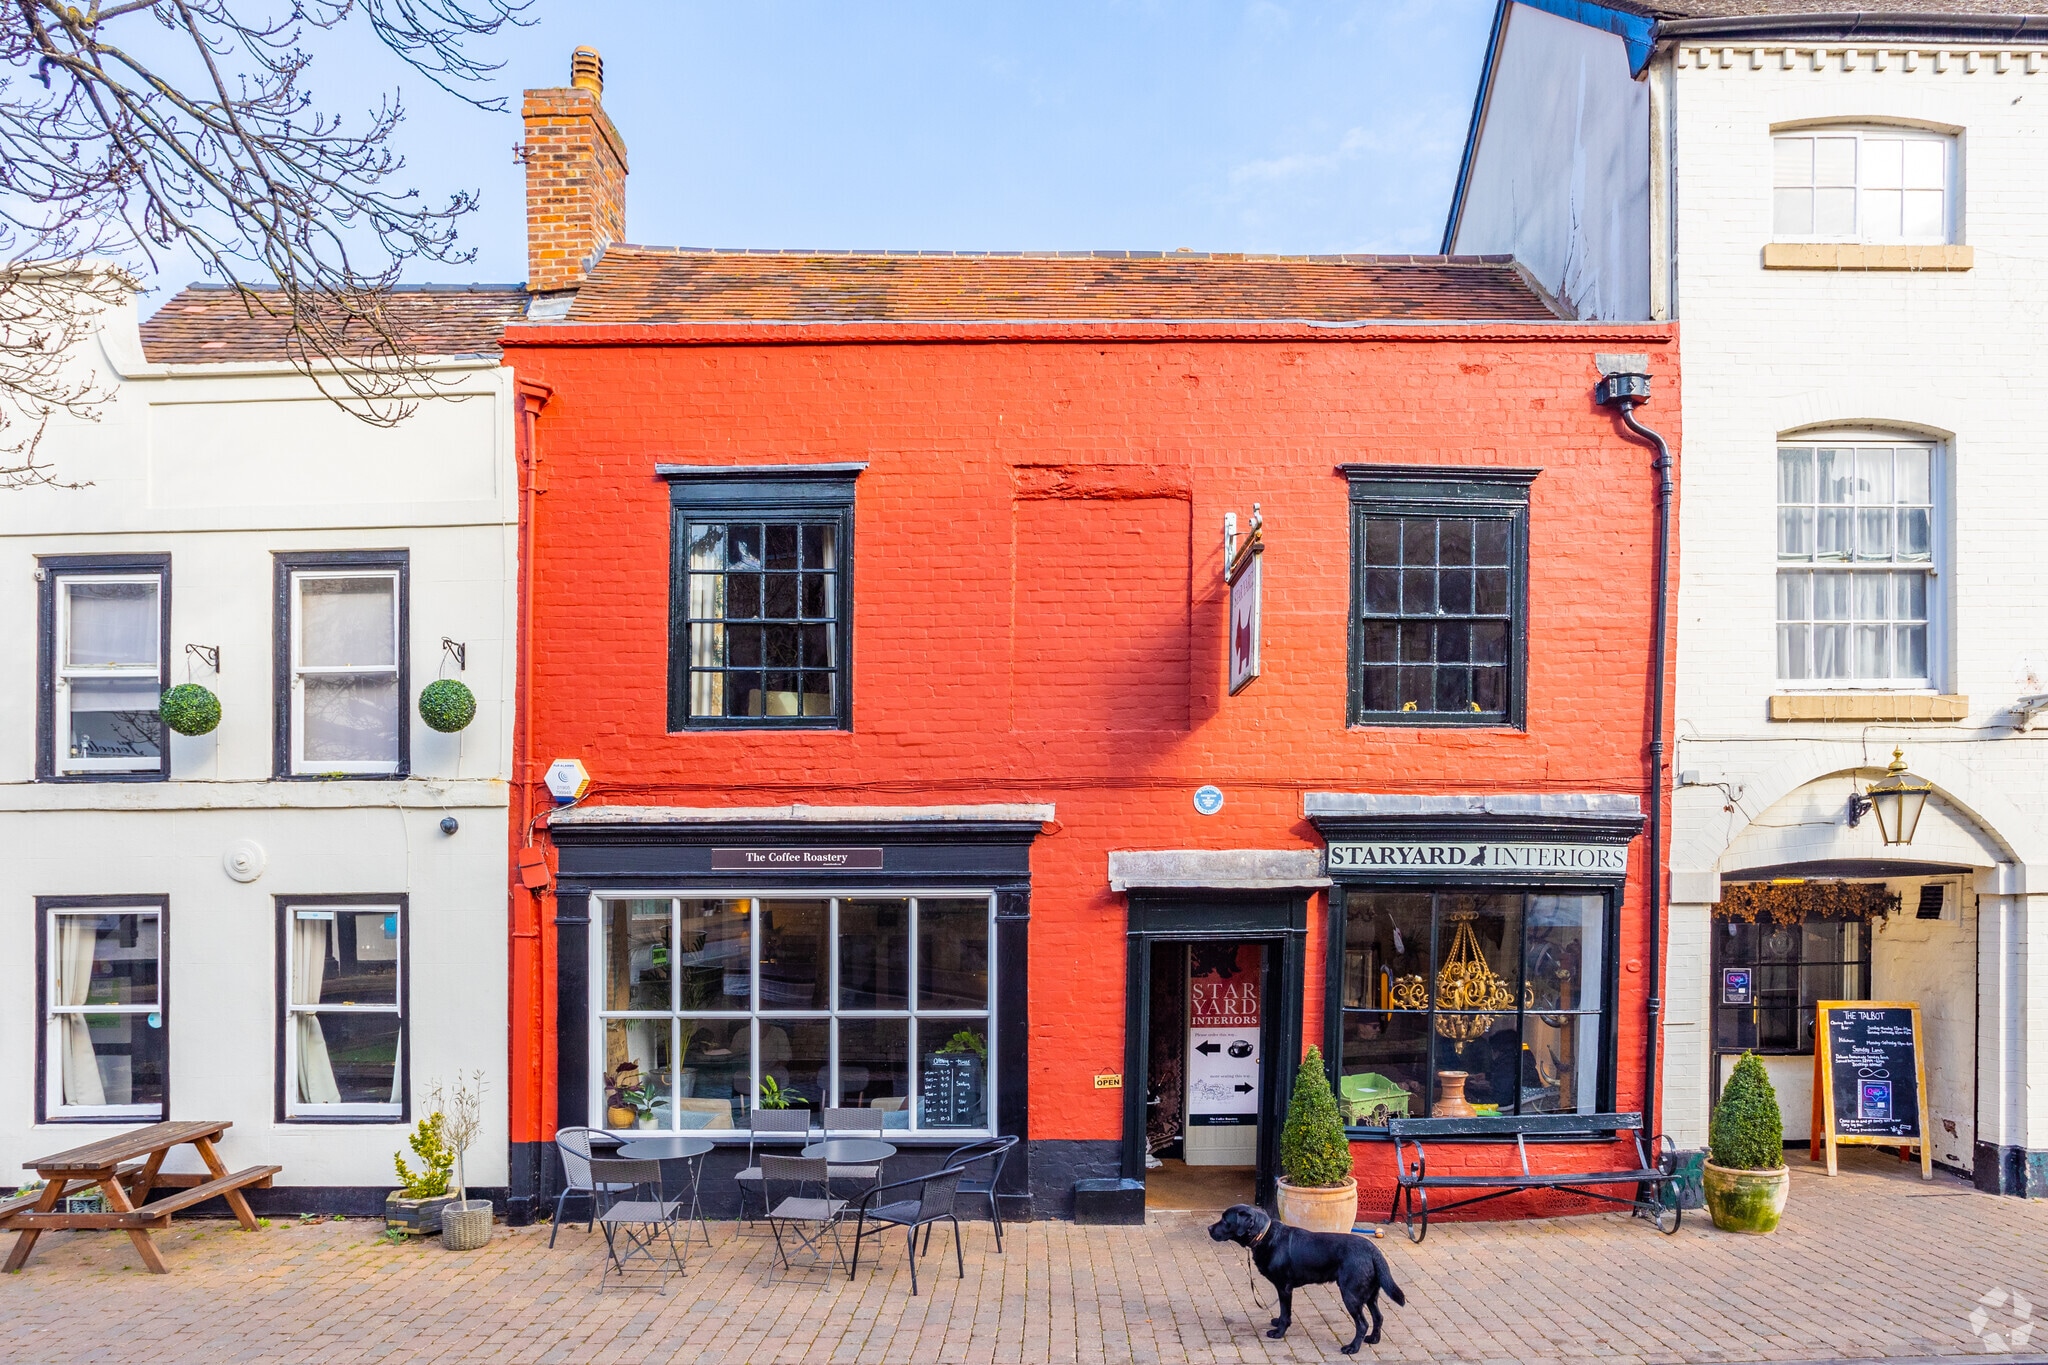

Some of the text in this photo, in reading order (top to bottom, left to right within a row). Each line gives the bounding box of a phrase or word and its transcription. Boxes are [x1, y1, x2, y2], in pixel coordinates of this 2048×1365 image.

[745, 852, 848, 864] The Coffee Roastery
[1331, 846, 1625, 868] STARYARD INTERIORS
[1192, 983, 1257, 1000] STAR
[1192, 999, 1257, 1015] YARD
[1192, 1016, 1257, 1025] INTERIORS
[1843, 1011, 1885, 1021] THE TALBOT
